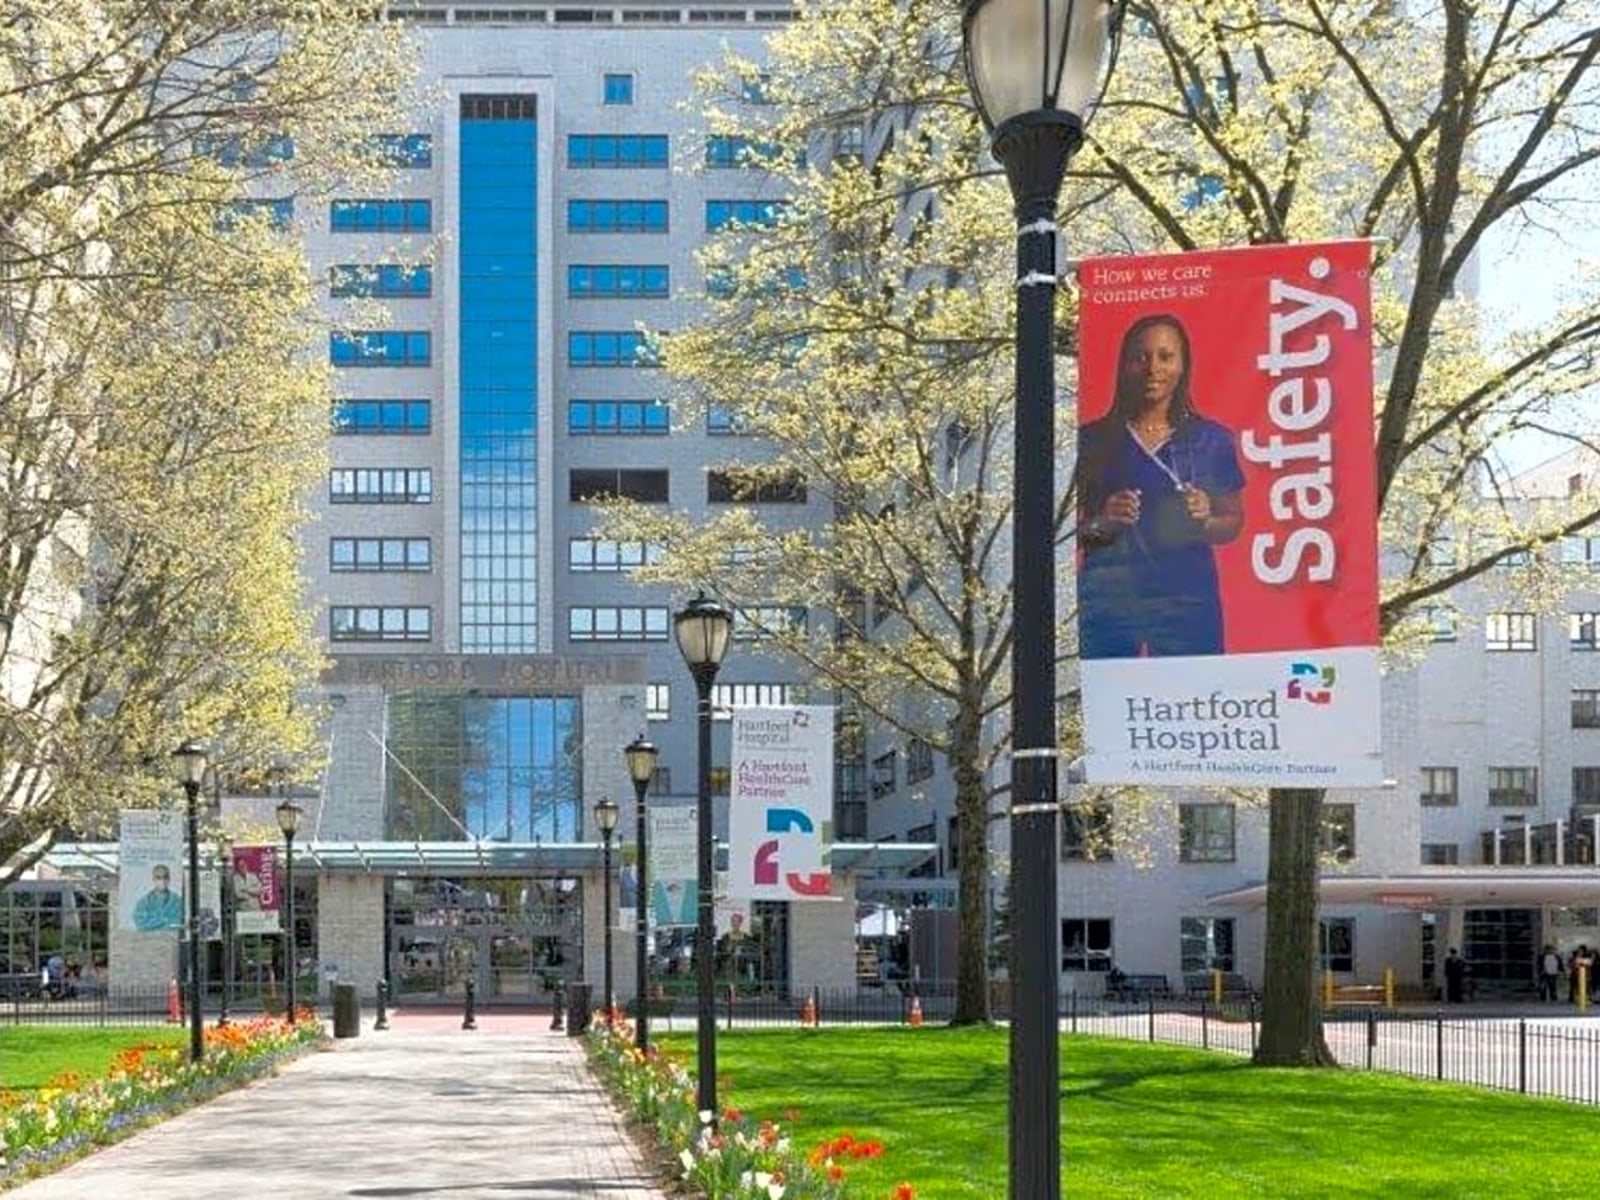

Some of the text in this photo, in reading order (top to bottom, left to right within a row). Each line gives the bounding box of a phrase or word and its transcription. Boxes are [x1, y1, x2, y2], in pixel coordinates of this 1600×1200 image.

[1093, 265, 1212, 285] How we care
[1092, 284, 1178, 305] connects
[1242, 257, 1358, 584] Safety.
[1125, 690, 1280, 722] Hartford
[1128, 723, 1281, 758] Hospital
